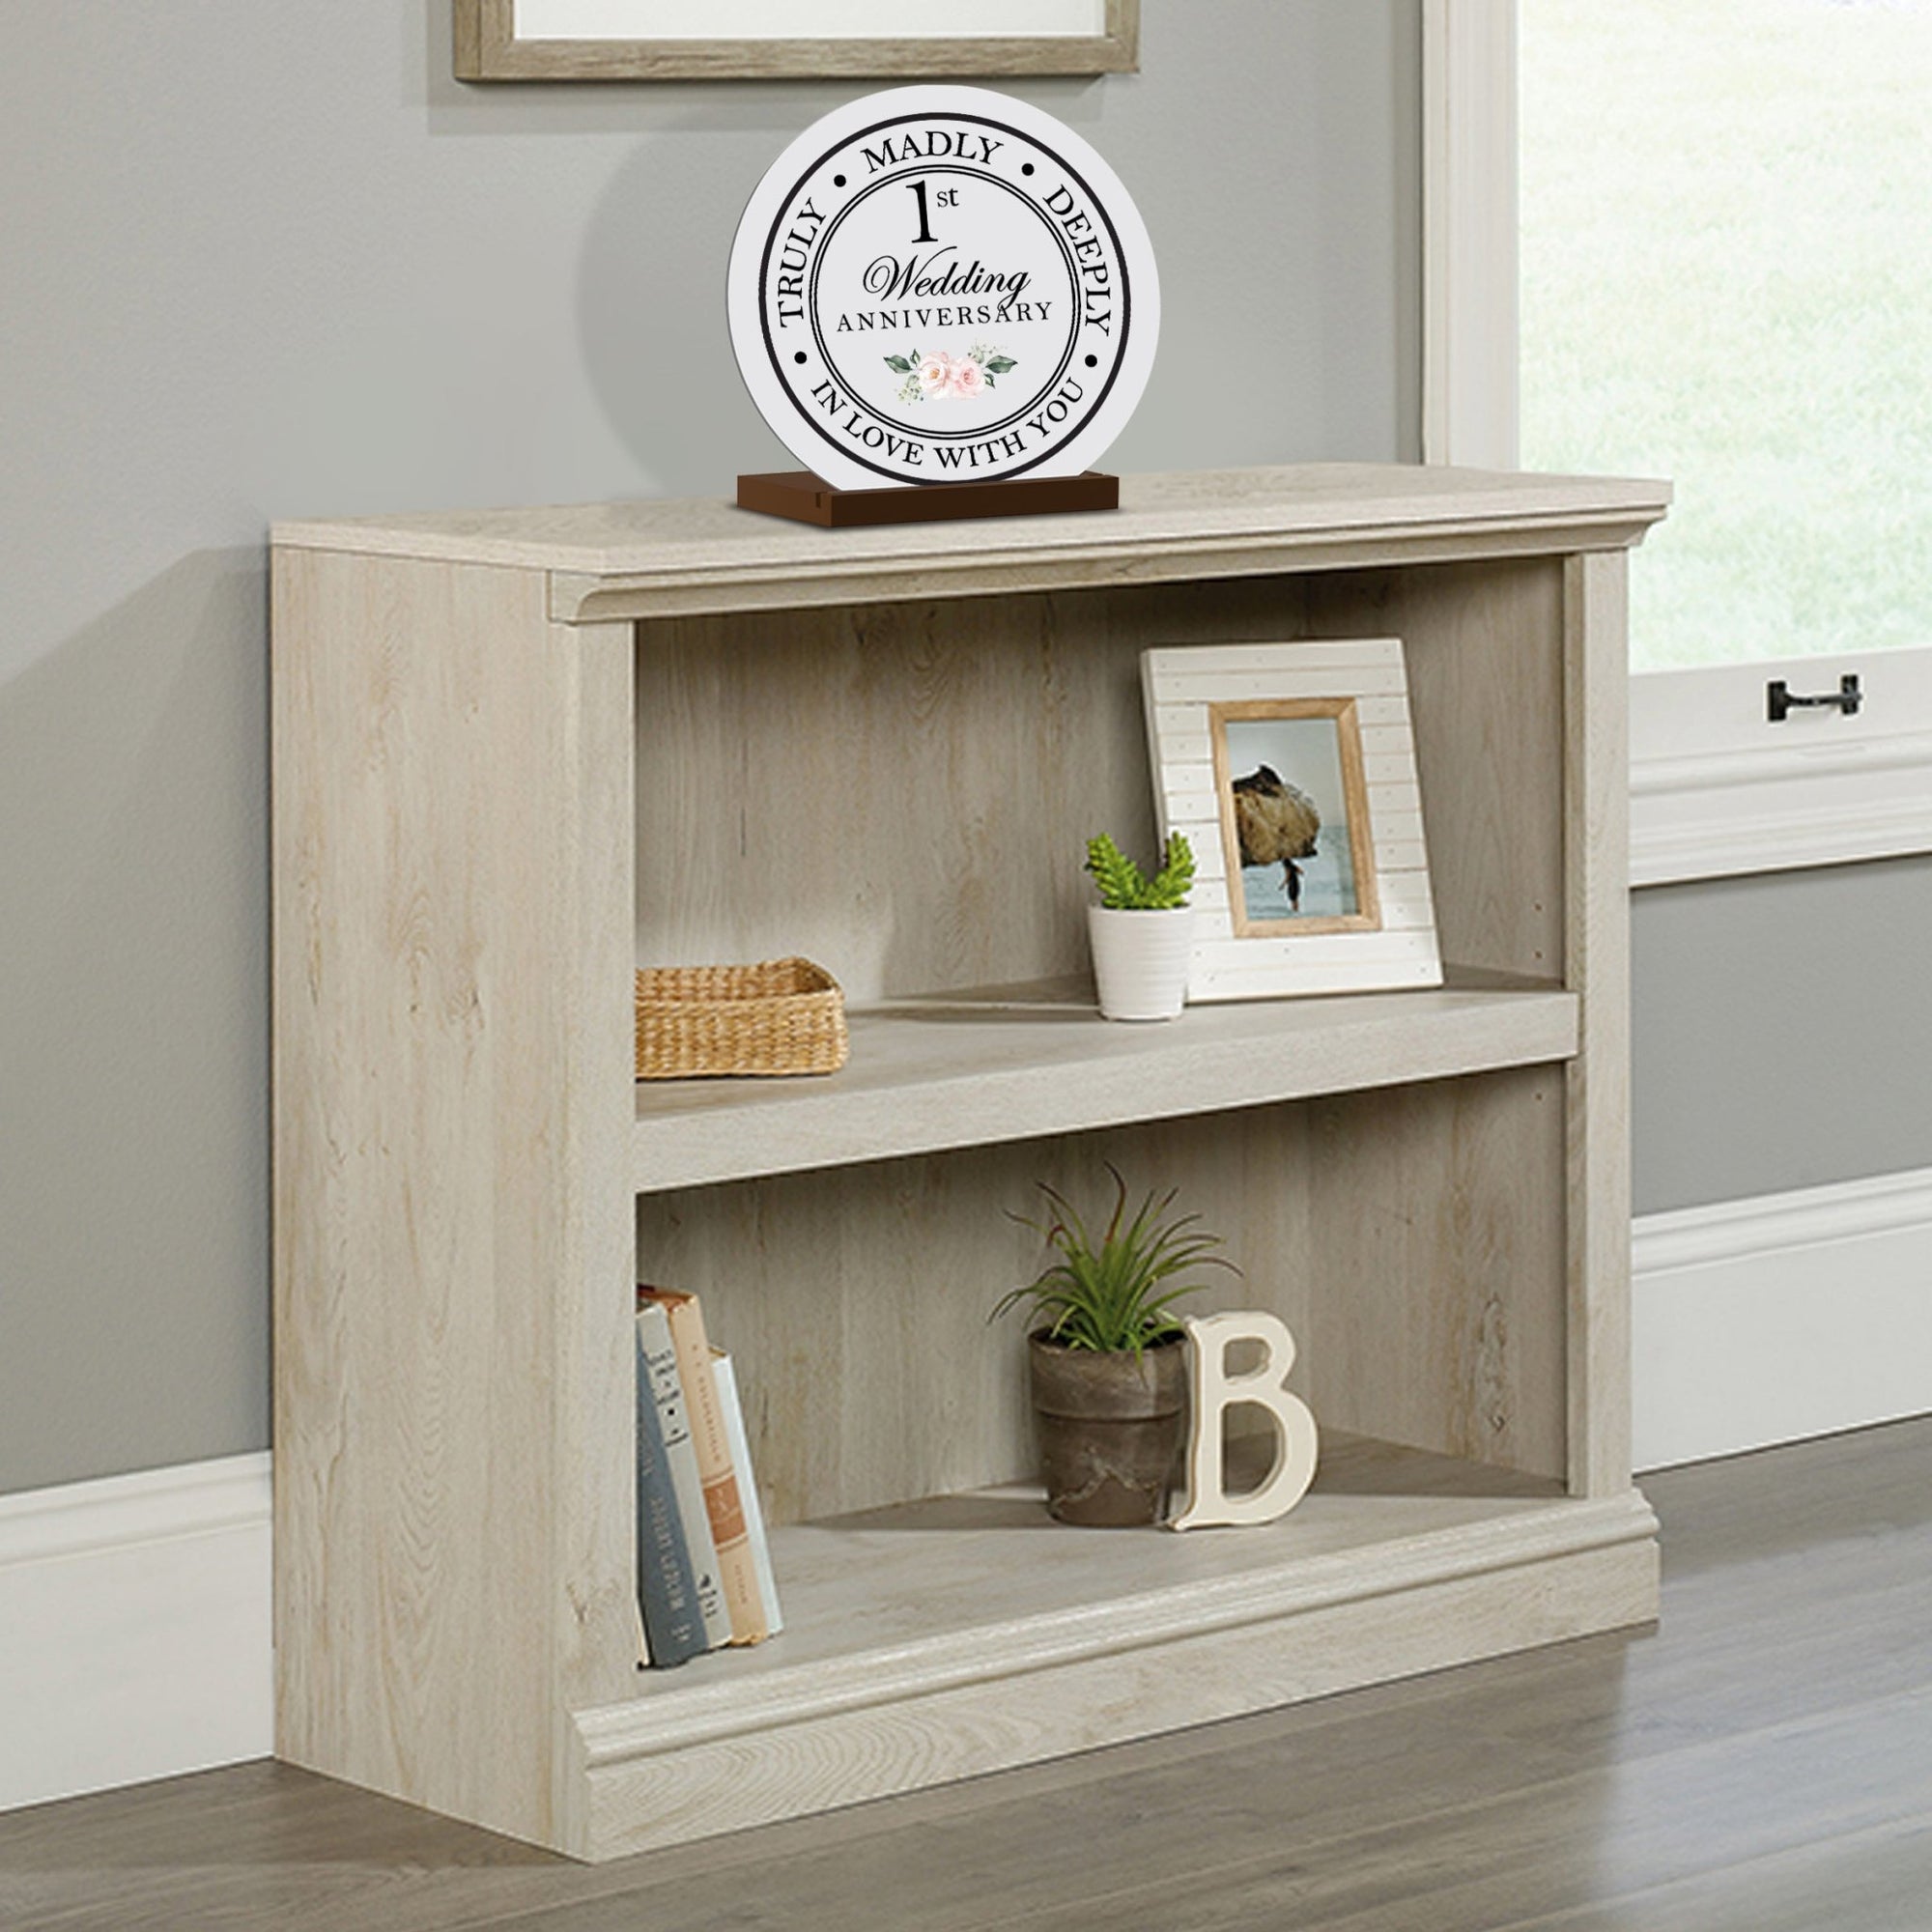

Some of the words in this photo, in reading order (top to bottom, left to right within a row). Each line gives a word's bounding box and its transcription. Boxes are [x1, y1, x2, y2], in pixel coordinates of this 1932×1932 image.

[777, 196, 827, 328] TRULY
[860, 130, 1005, 175] MADLY
[1041, 184, 1112, 337] DEEPLY
[905, 179, 959, 244] 1st
[837, 301, 1053, 332] ANNIVERSARY
[862, 245, 1032, 310] Wedding
[810, 378, 848, 416] IN
[841, 411, 924, 467] LOVE
[932, 429, 1028, 469] WITH
[1025, 376, 1084, 438] YOU
[1167, 1310, 1319, 1532] B
